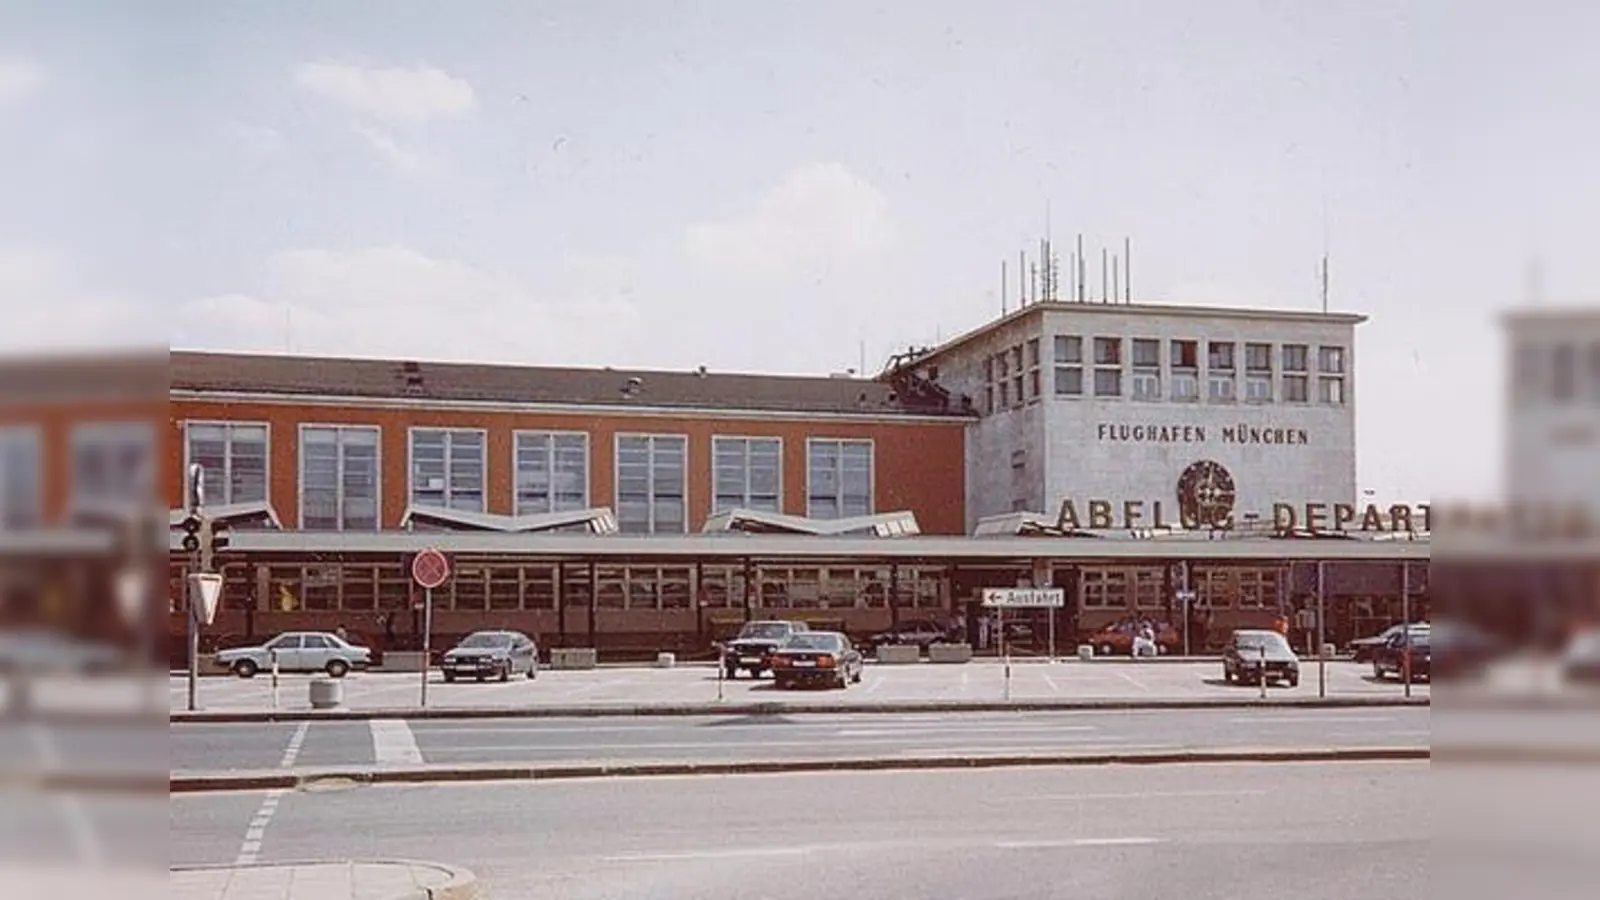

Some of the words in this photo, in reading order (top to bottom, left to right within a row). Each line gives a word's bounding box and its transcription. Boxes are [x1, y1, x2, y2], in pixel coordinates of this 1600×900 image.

[1098, 424, 1206, 441] FLUGHAFEN
[1222, 424, 1309, 445] MÜNCHEN
[1057, 499, 1235, 530] ABFLUG
